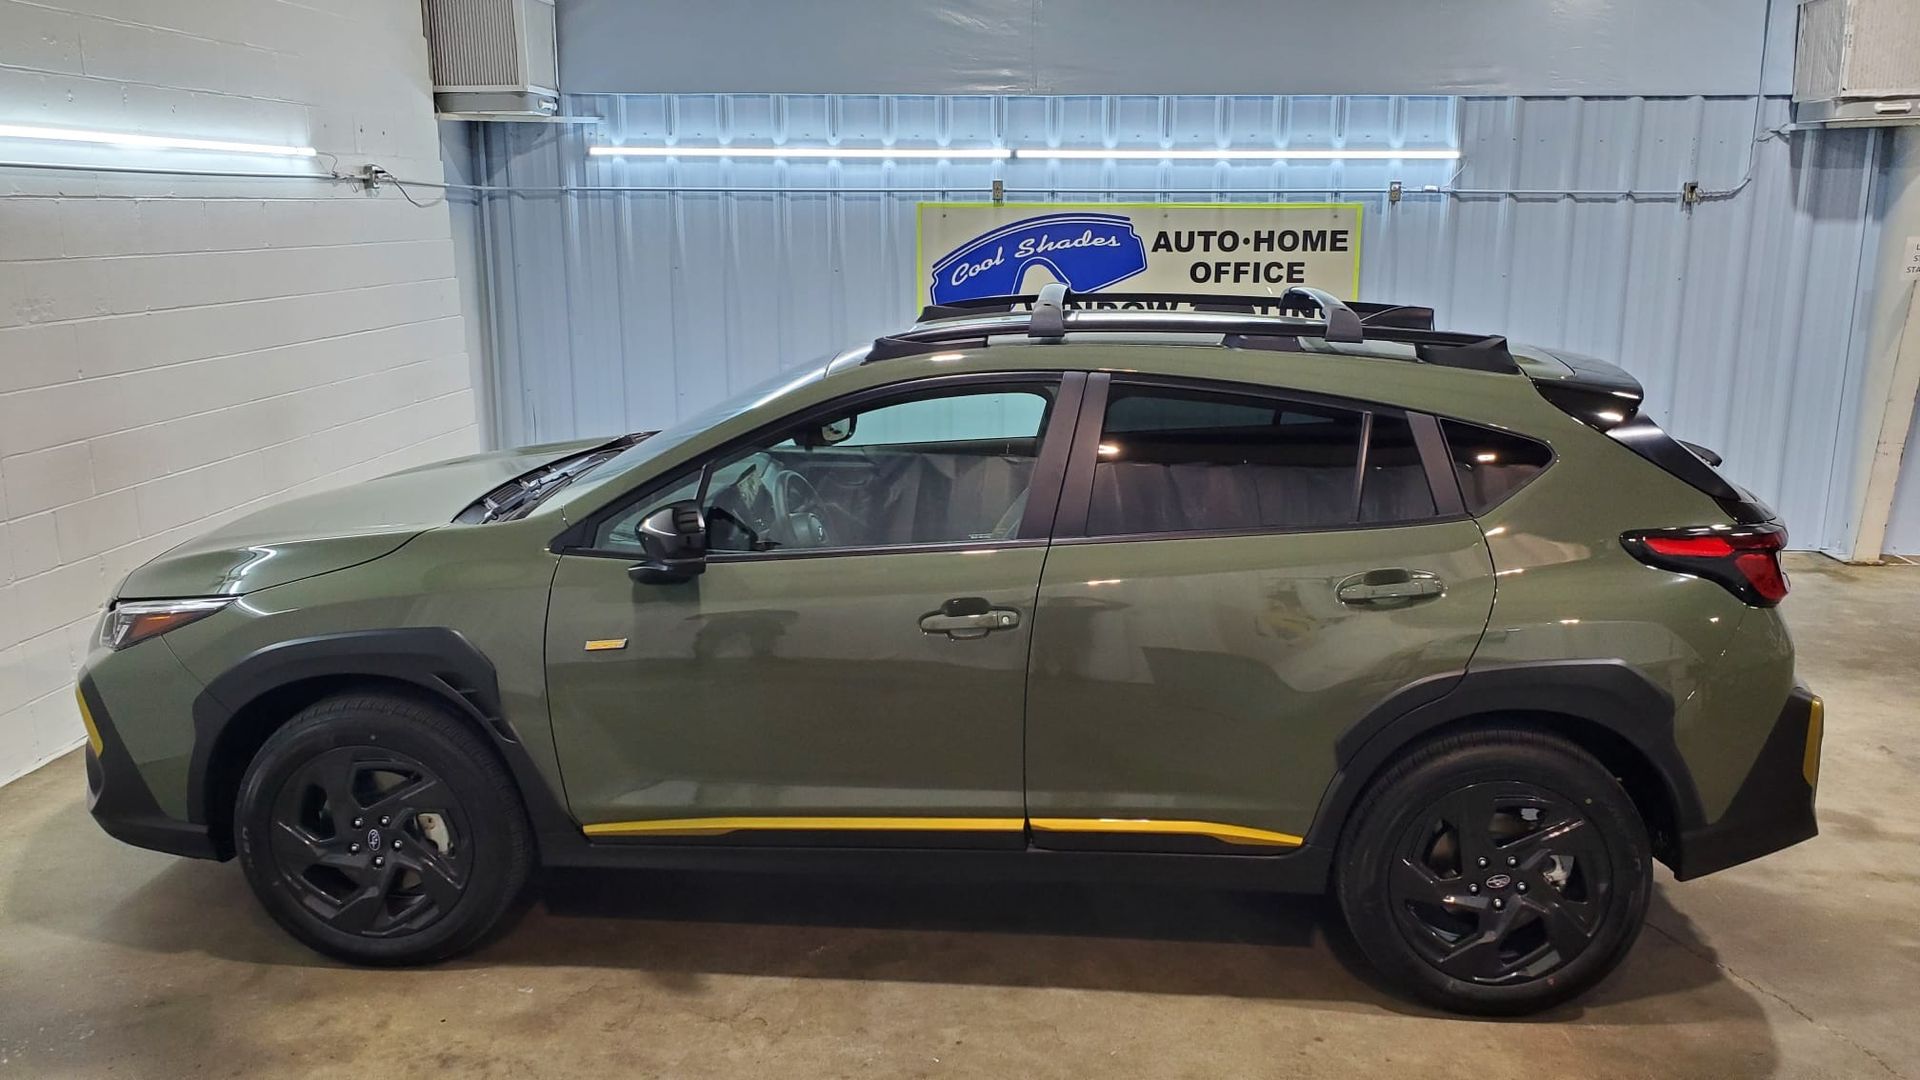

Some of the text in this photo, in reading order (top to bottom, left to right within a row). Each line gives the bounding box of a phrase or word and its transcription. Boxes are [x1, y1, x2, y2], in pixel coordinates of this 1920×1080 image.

[951, 229, 1121, 286] Cool Shades
[1190, 261, 1305, 283] OFFICE
